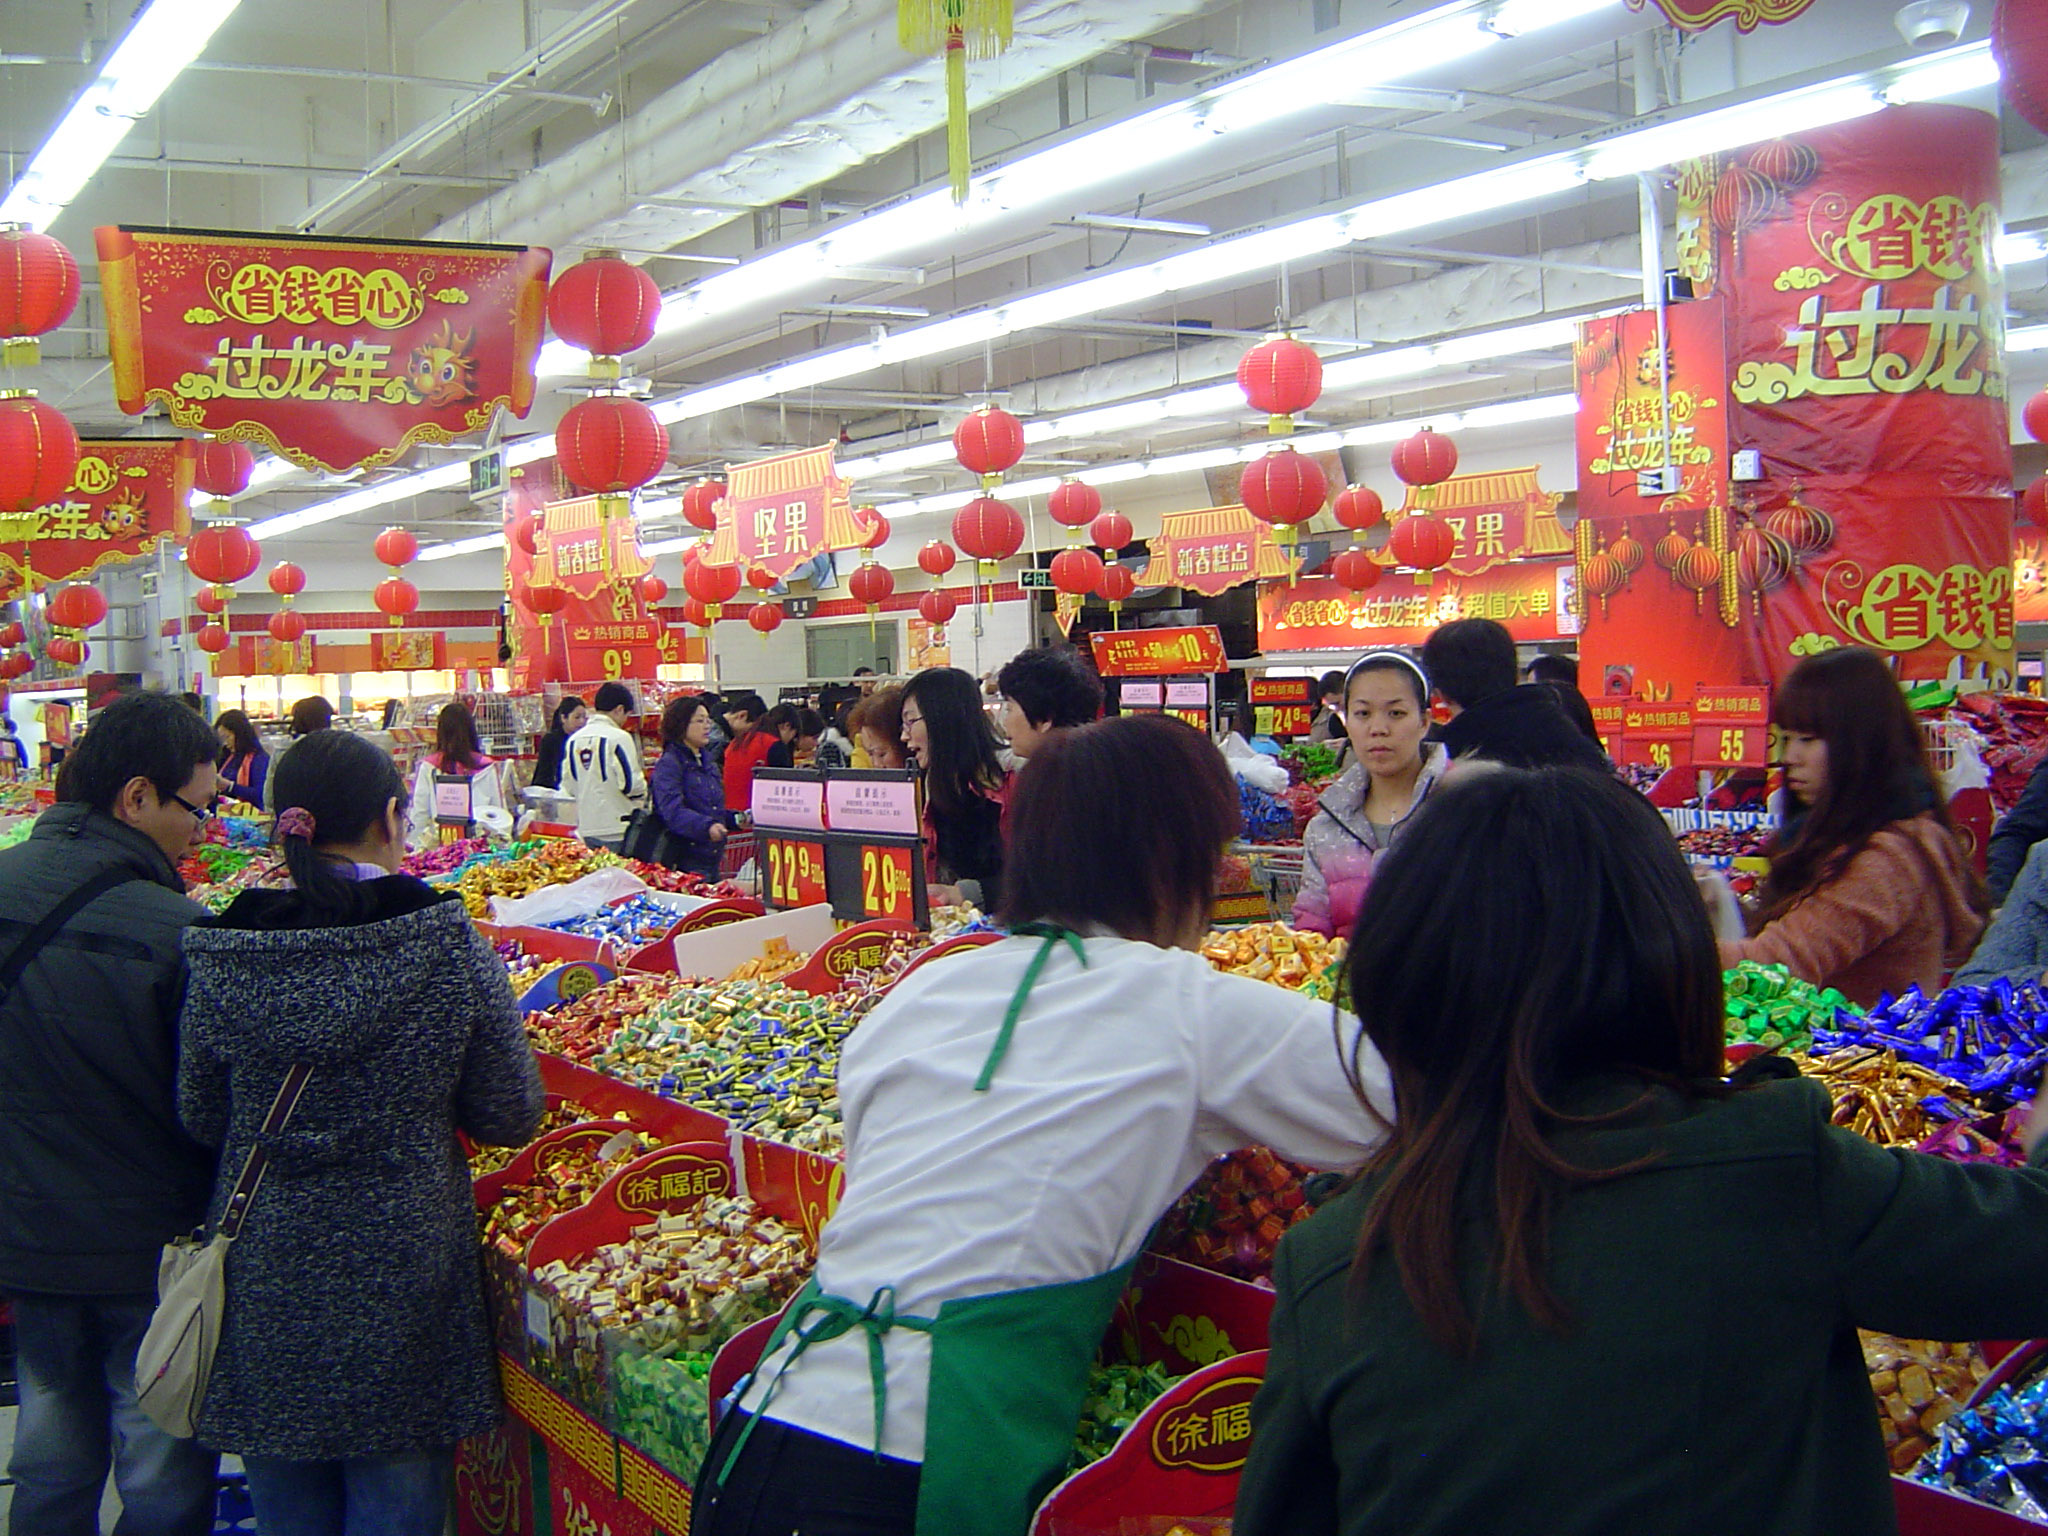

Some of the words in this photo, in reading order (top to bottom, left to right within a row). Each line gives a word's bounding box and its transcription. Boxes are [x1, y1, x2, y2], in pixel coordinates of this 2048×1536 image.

[236, 268, 408, 322] 省钱省心
[1784, 285, 2000, 396] 过龙
[209, 335, 392, 400] 过龙年
[1606, 427, 1695, 471] 过龙年
[754, 500, 810, 559] 坚果
[557, 539, 613, 577] 新春糕
[1177, 542, 1249, 577] 新春糕点
[1365, 595, 1428, 628] 过龙年
[1466, 588, 1550, 619] 超值大单
[594, 625, 649, 640] 热销商品
[1644, 711, 1691, 727] 热销商品
[1714, 697, 1762, 713] 热销商品
[1650, 743, 1671, 769] 36
[1720, 729, 1744, 761] 55
[863, 851, 897, 914] 29
[833, 944, 883, 972] 徐福
[627, 1166, 722, 1206] 徐福記
[1166, 1400, 1252, 1456] 徐福
